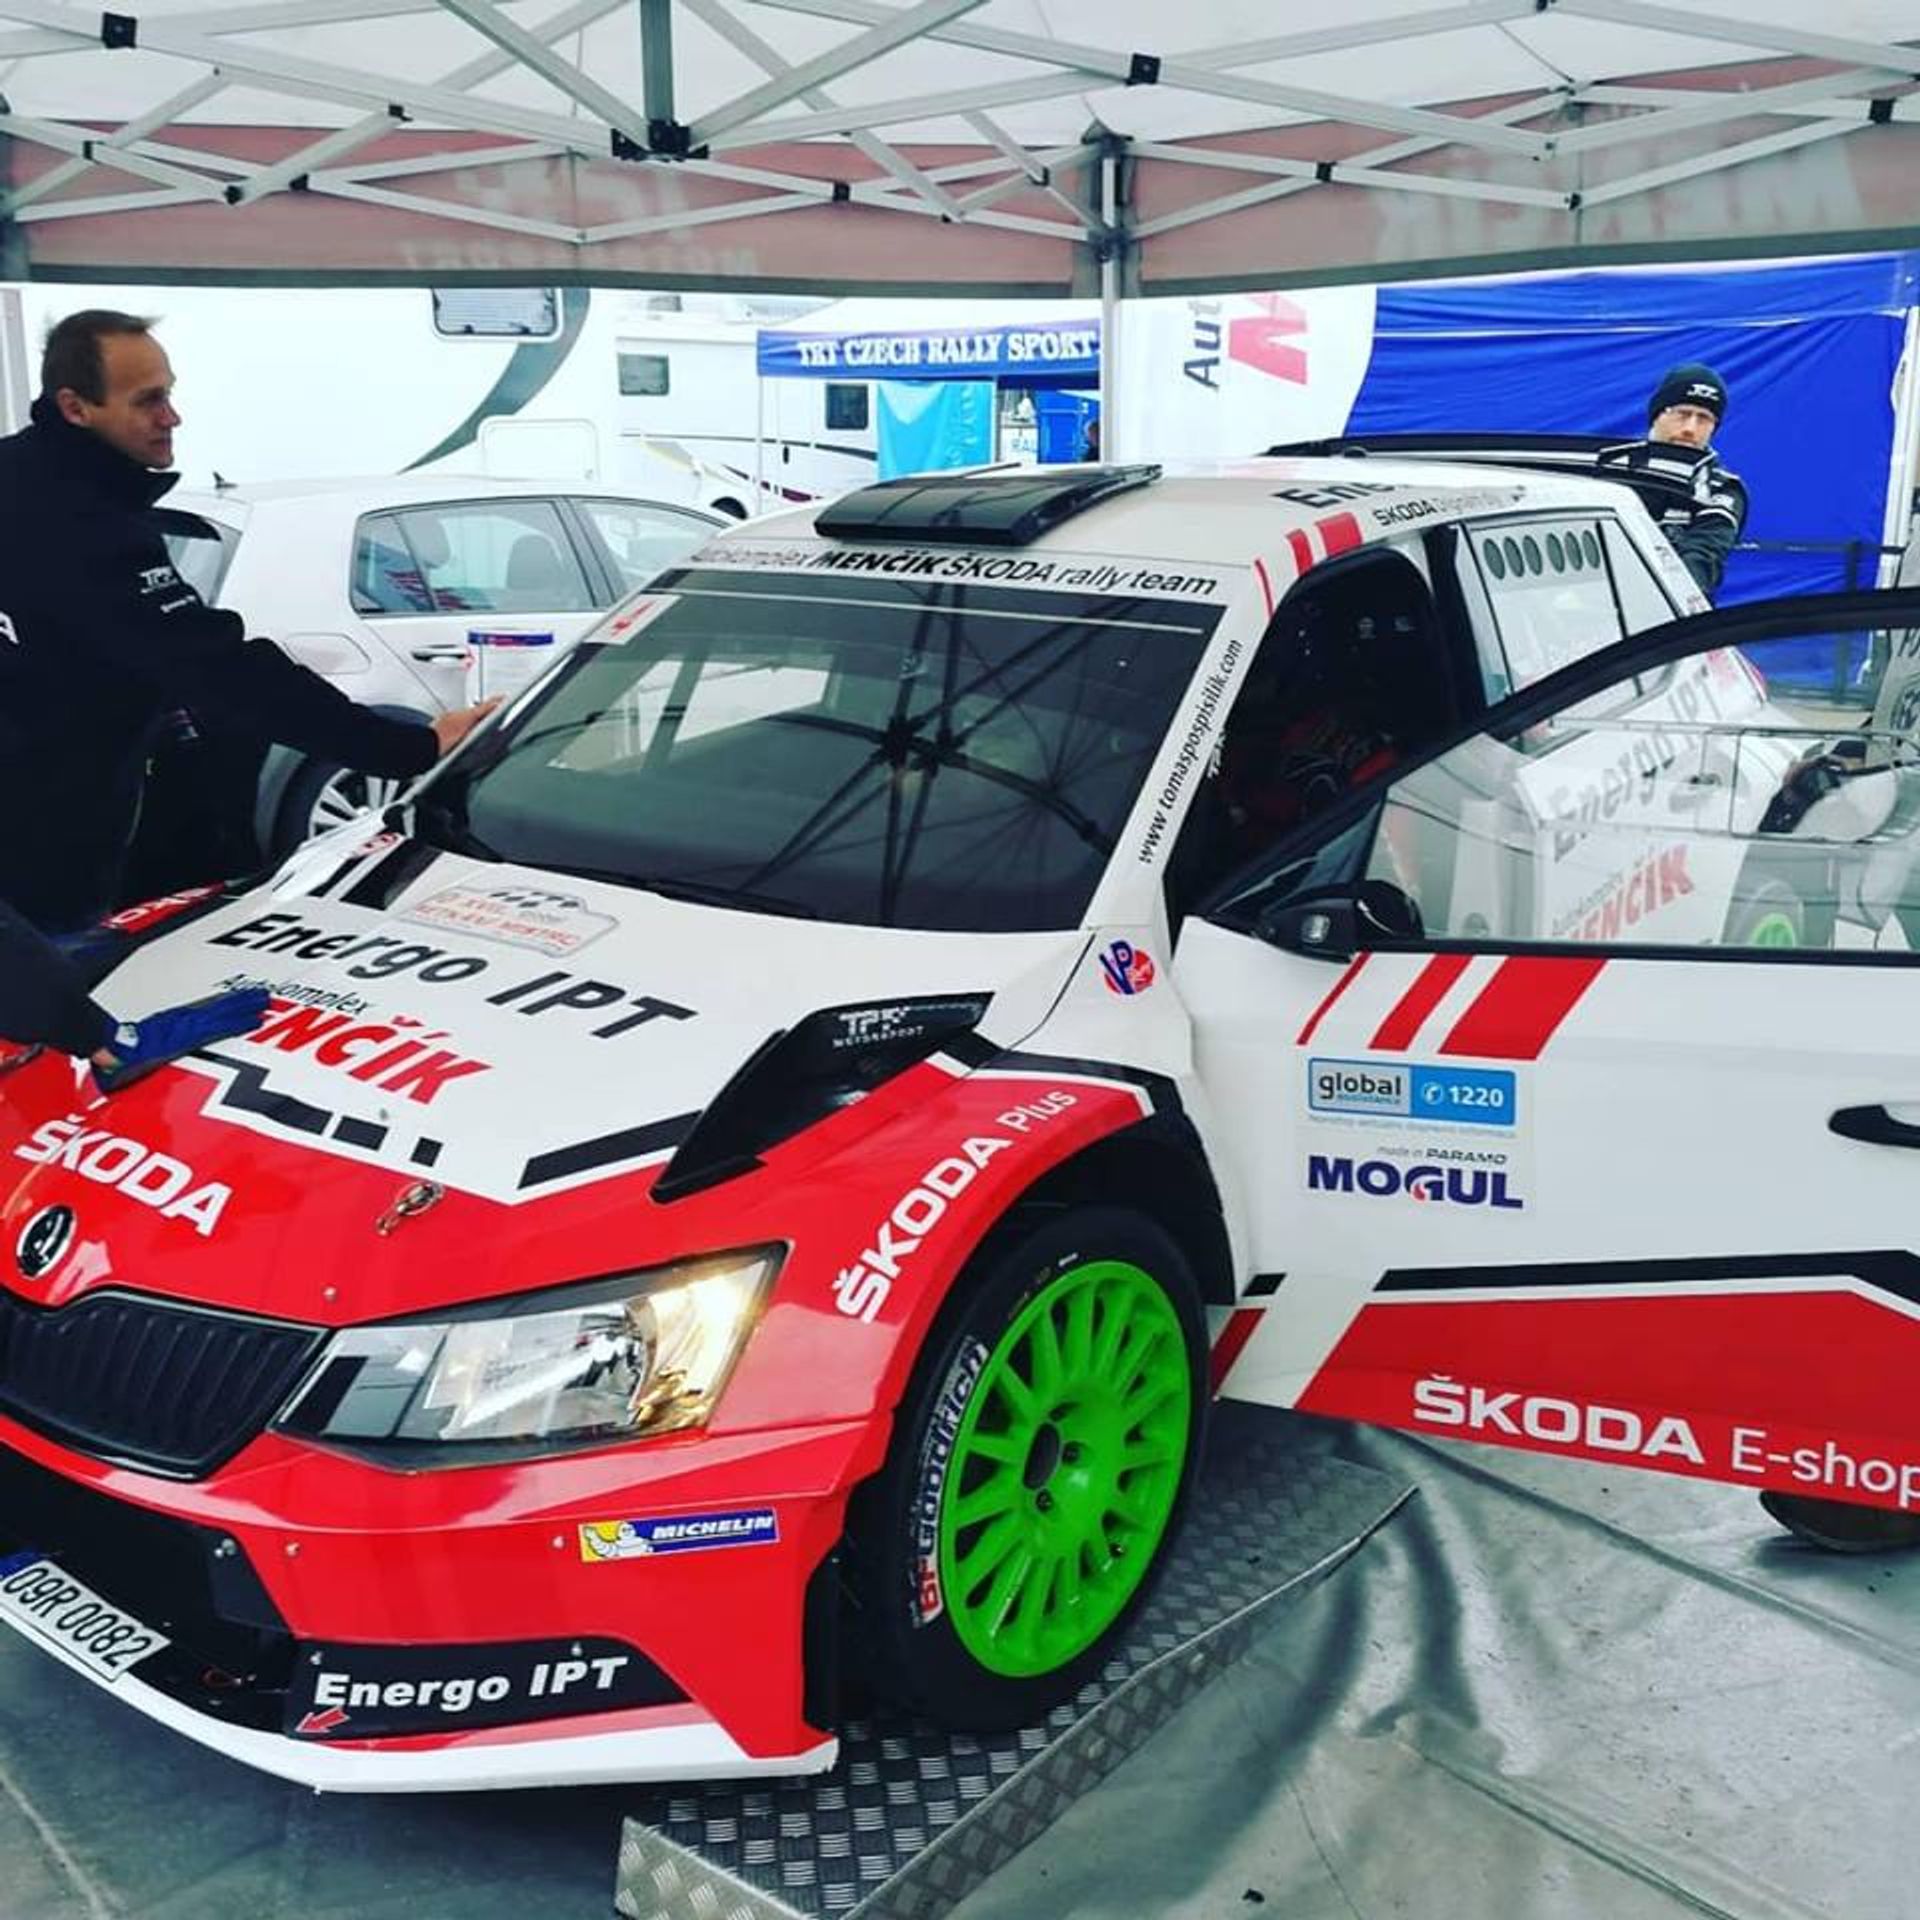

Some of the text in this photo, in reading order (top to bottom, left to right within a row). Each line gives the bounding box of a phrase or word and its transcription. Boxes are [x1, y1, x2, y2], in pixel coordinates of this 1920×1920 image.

[845, 339, 920, 365] CZECH
[928, 336, 1001, 362] RALLY
[1008, 332, 1097, 360] SPORT
[808, 550, 948, 575] MENČÍK
[942, 552, 1055, 582] ŠKODA
[1055, 566, 1131, 591] rally
[1130, 570, 1217, 595] team
[208, 914, 699, 1039] Energo IPT
[245, 998, 493, 1105] ENČÍK
[1319, 1073, 1401, 1099] global
[1450, 1085, 1504, 1107] 1220
[14, 1114, 233, 1237] ŠKODA
[1308, 1155, 1523, 1209] MOGUL
[1426, 1148, 1508, 1165] PARAMO
[832, 1091, 1078, 1324] ŠKODA Plus
[1413, 1374, 1705, 1465] ŠKODA
[652, 1516, 774, 1540] MICHELIN
[3, 1567, 152, 1668] 09R 0082
[314, 1657, 628, 1712] Energo IPT
